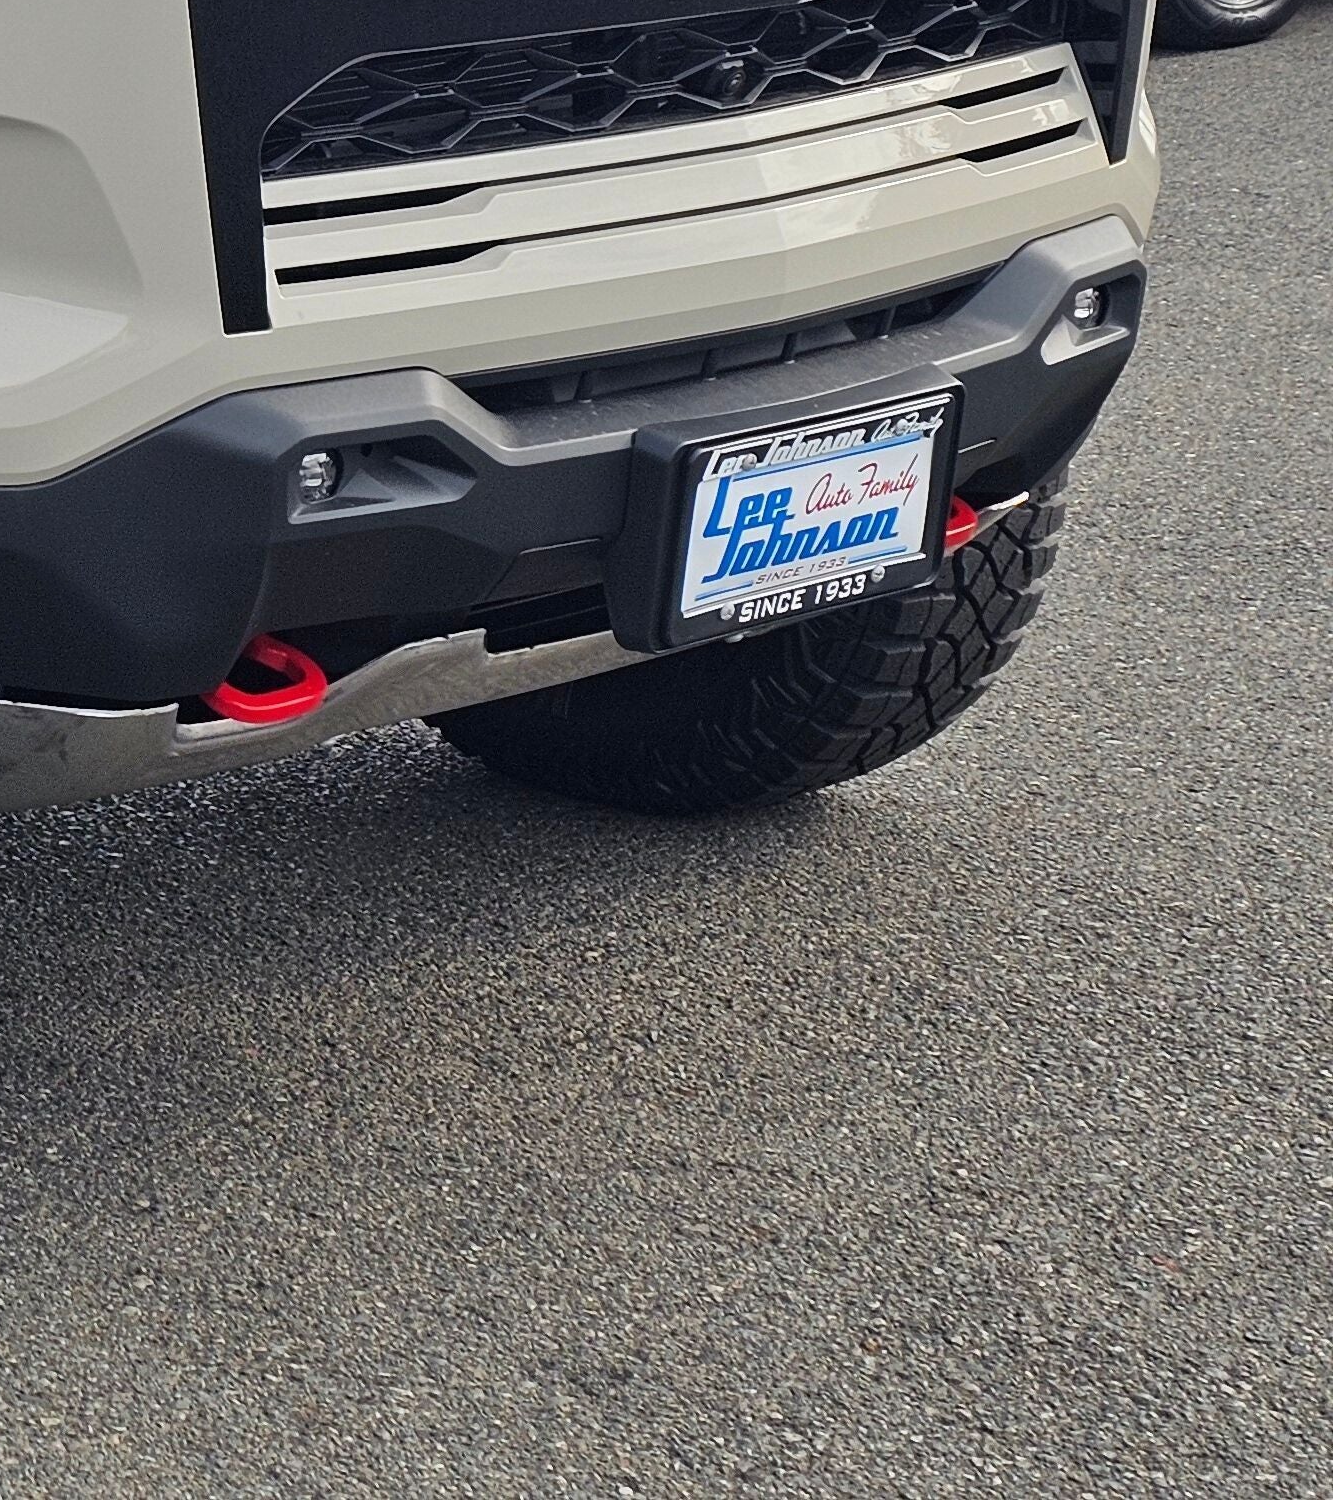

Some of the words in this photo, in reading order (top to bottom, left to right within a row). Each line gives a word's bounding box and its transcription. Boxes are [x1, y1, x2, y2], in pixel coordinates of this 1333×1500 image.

[757, 428, 867, 469] Johnson
[702, 475, 795, 538] Lee
[805, 472, 853, 515] Auto
[857, 453, 919, 506] Family
[700, 506, 900, 584] Johnson
[755, 565, 805, 585] SINCE
[808, 556, 847, 573] 1933
[738, 588, 807, 623] SINCE
[814, 573, 867, 605] 1933
